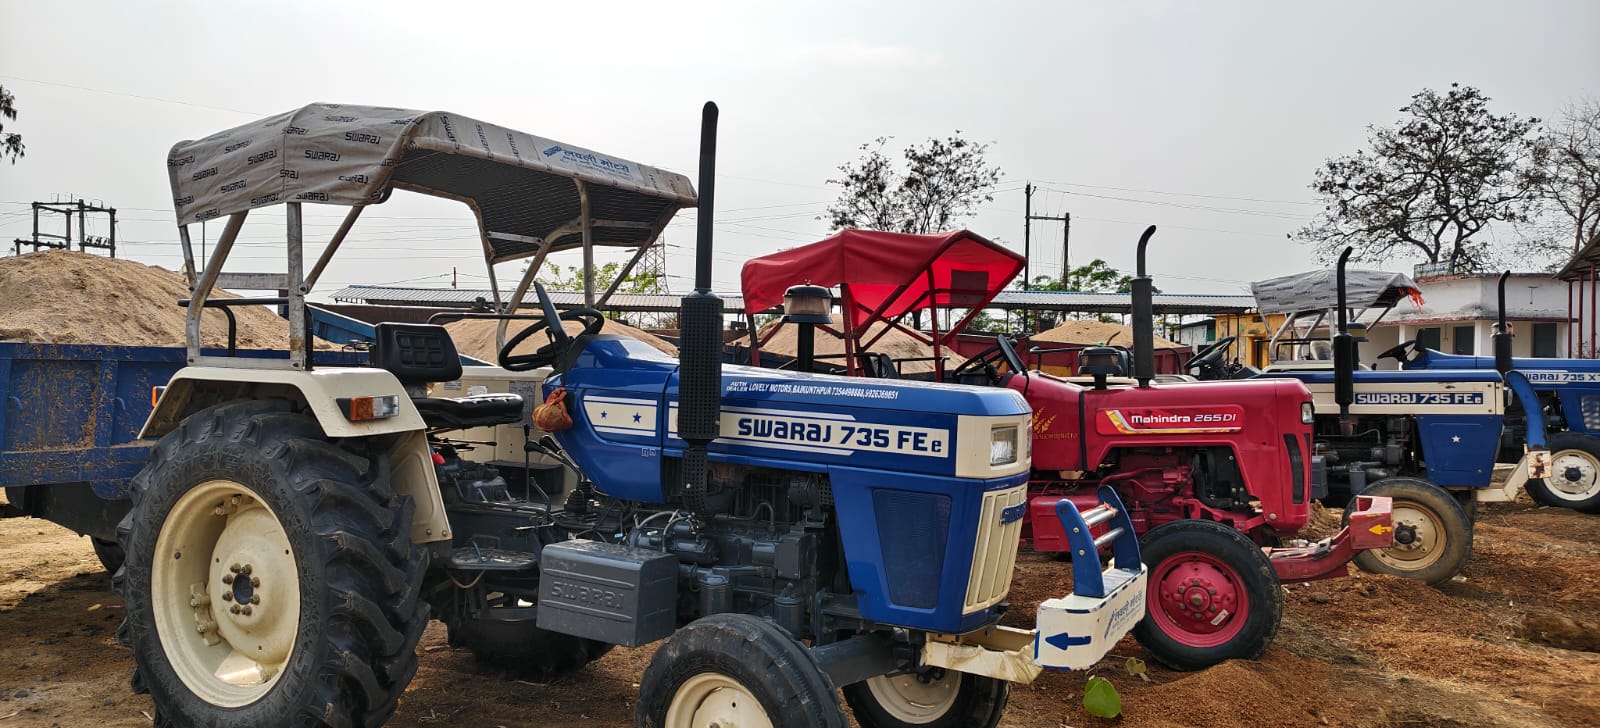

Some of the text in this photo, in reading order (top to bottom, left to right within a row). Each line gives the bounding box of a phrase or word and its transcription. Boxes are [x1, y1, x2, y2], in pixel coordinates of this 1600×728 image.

[248, 148, 277, 165] SWARAJ
[304, 150, 341, 162] SWARAJ
[1563, 373, 1585, 381] 735
[748, 383, 770, 392] LOVELY
[1357, 393, 1417, 404] SWARAJ
[1419, 393, 1451, 404] 735
[1131, 415, 1191, 423] Mahindra
[738, 417, 832, 444] SWARAJ
[839, 425, 891, 450] 735
[552, 581, 624, 608] SWARAJ
